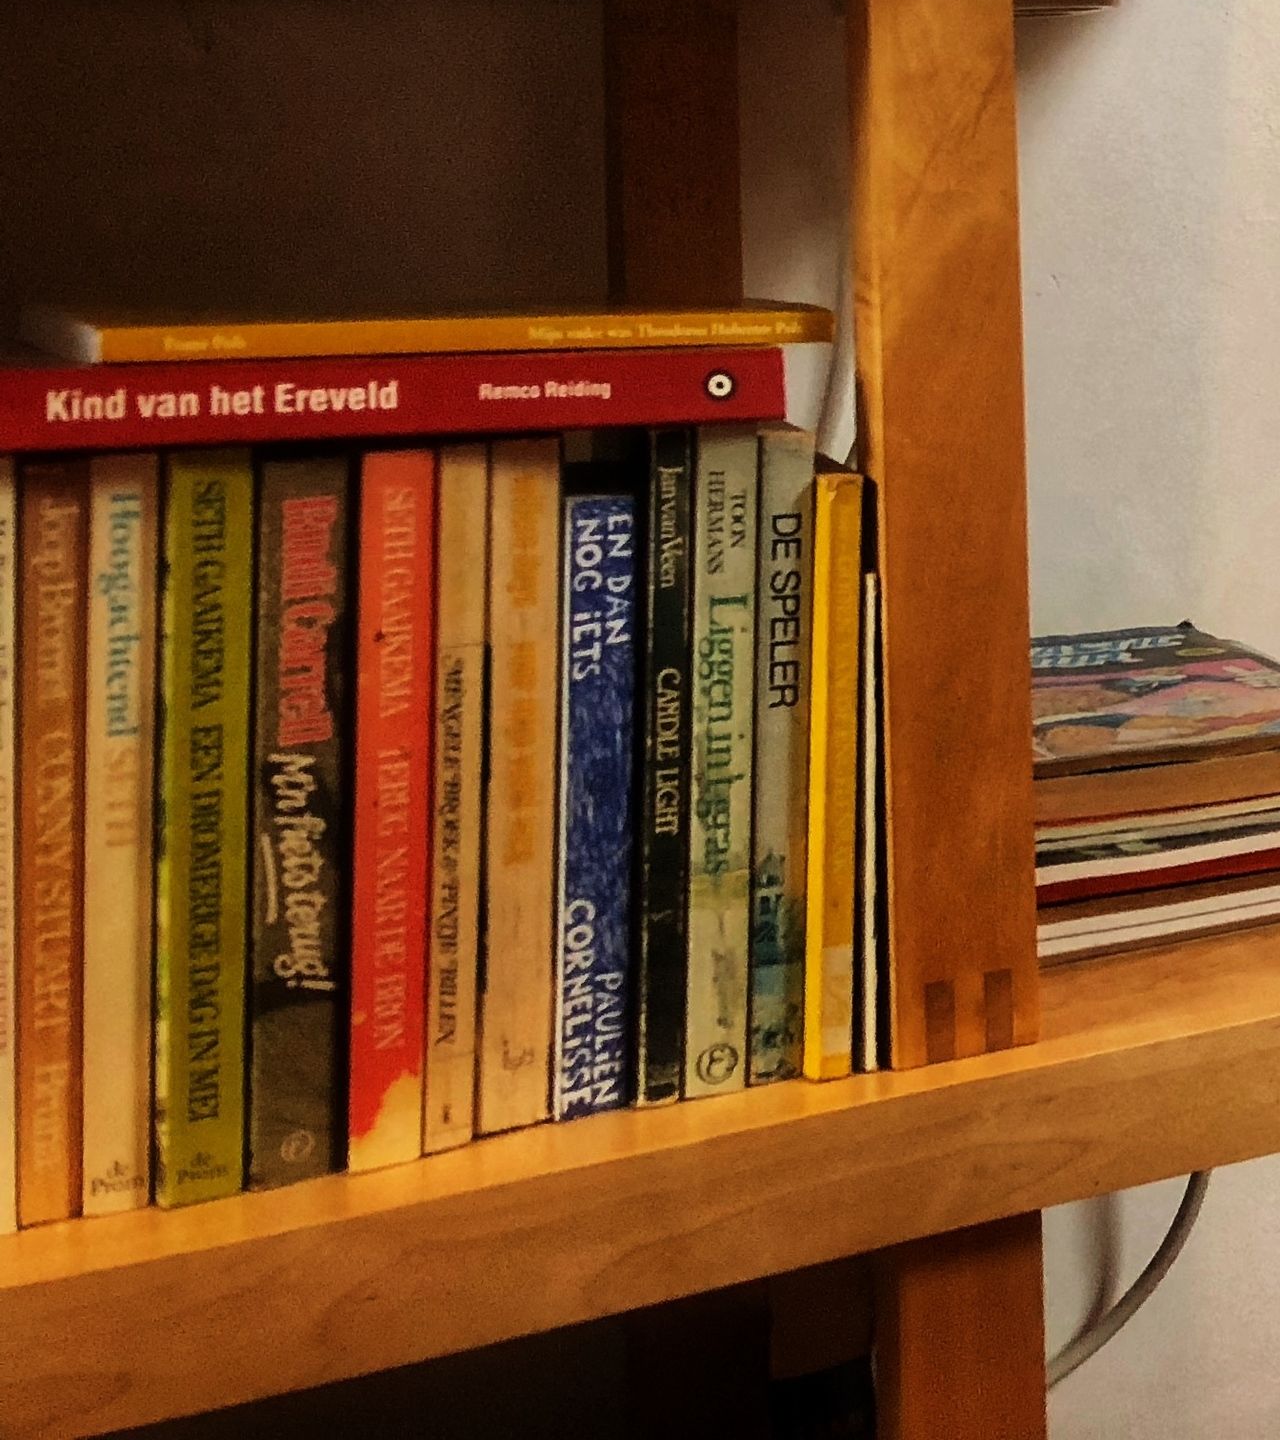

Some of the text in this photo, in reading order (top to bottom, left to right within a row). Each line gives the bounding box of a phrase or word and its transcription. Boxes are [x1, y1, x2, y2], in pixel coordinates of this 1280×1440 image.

[46, 379, 399, 423] Kind van het Ereveld
[479, 383, 540, 401] Remco
[379, 486, 418, 559] SETH
[572, 516, 604, 592] NOG
[657, 536, 684, 588] Veen
[705, 469, 728, 576] HERMANS
[728, 490, 750, 549] TOON
[98, 491, 142, 738] Hoogachtend
[603, 514, 634, 647] EN DAN
[768, 513, 804, 708] DE SPELER
[377, 565, 416, 718] GAAIKEMA
[697, 592, 750, 724] Liggen
[375, 746, 413, 837] TERUG
[652, 666, 683, 837] CANDLE LIGHT
[704, 731, 747, 769] in
[187, 479, 227, 1123] SETH GAAIKEMA EEN DROMERIGE DAG IN MEI
[273, 812, 328, 888] fiets
[374, 844, 411, 922] NAAR
[273, 892, 337, 990] terug!
